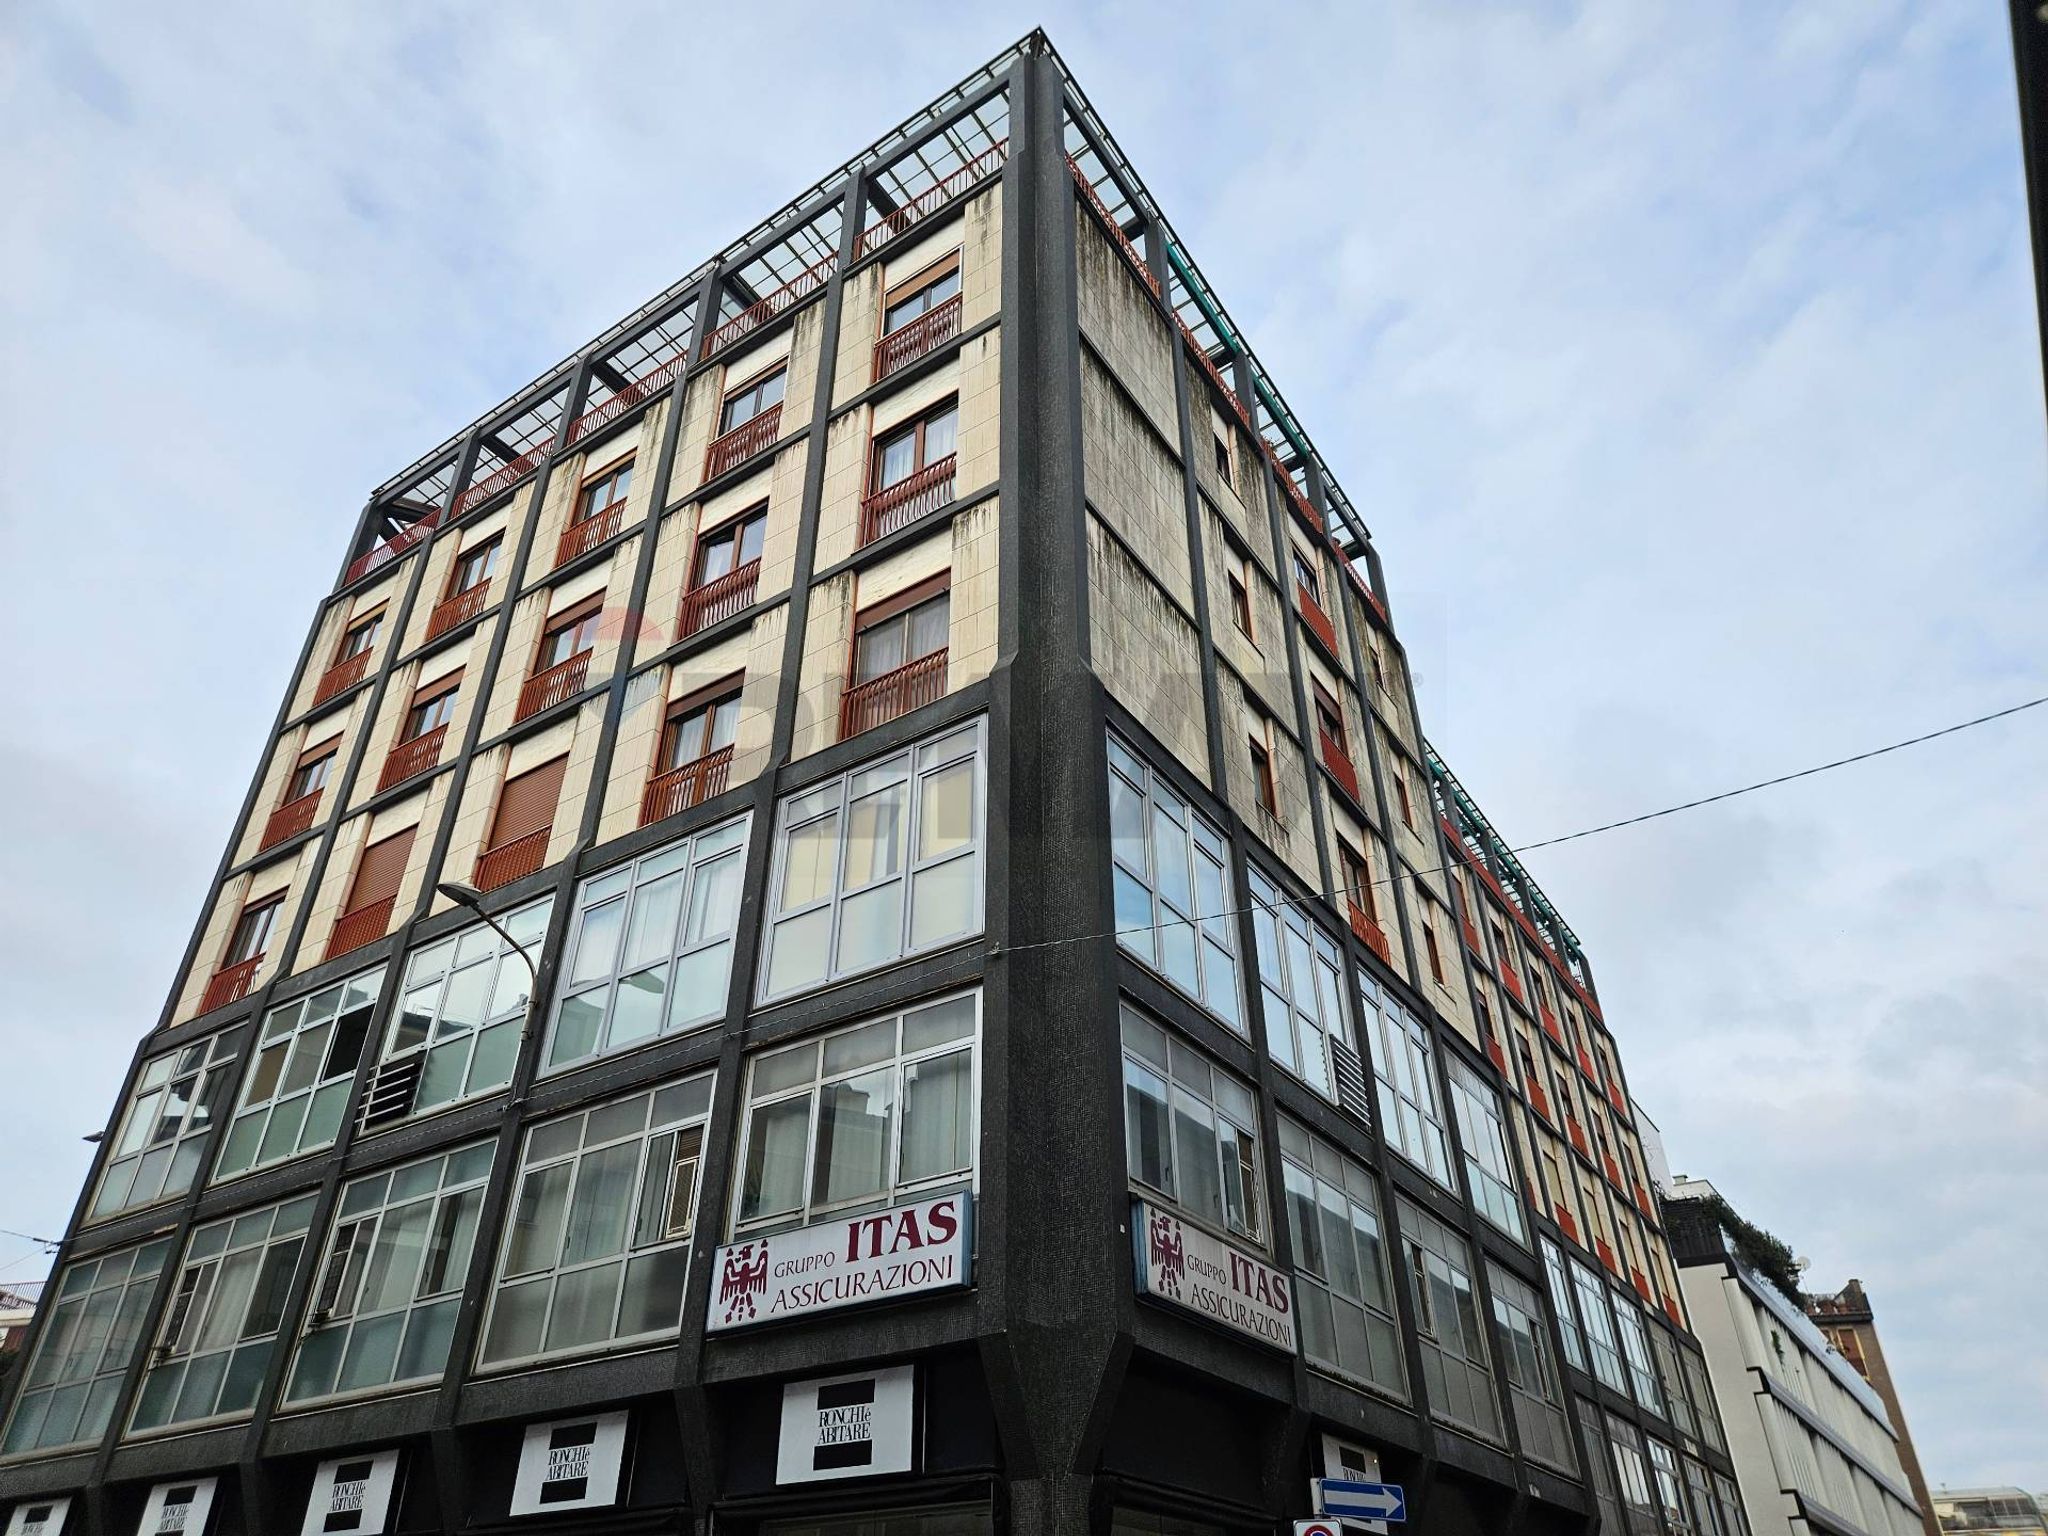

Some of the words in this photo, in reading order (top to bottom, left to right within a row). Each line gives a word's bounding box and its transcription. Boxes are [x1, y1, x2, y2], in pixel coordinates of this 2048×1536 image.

[774, 1252, 836, 1278] GRUPPO
[845, 1201, 957, 1263] ITAS
[771, 1255, 953, 1313] ASSICURAZIONI
[1187, 1254, 1227, 1285] GRUPPO
[1229, 1251, 1289, 1314] ITAS
[1191, 1283, 1292, 1347] ASSICURAZIONI
[817, 1422, 871, 1444] ABITARE
[545, 1461, 589, 1481] ABITARE
